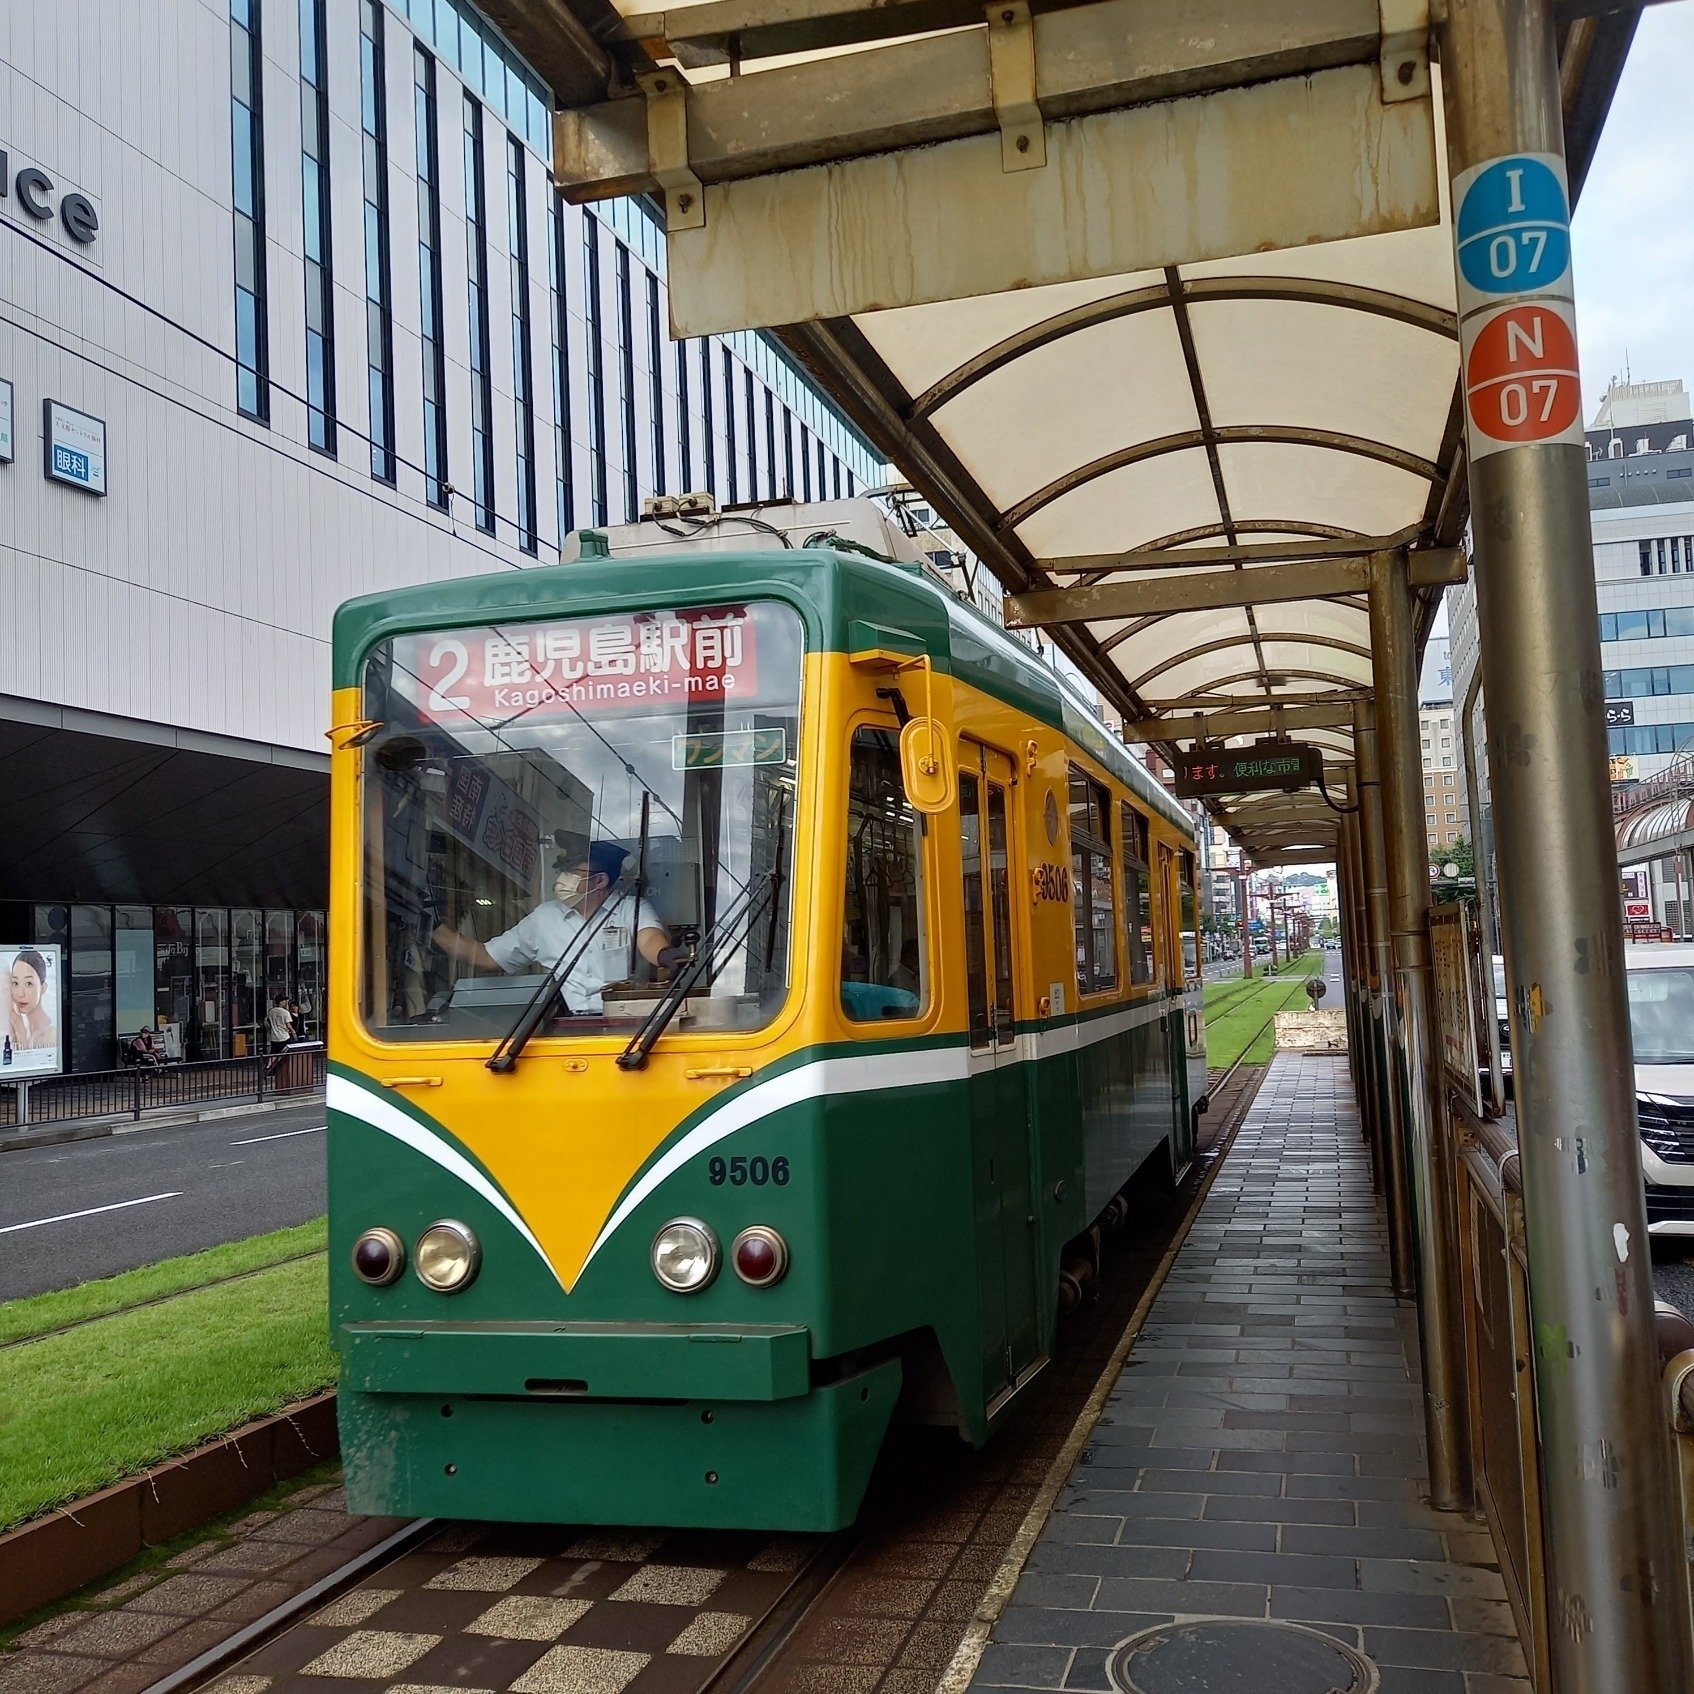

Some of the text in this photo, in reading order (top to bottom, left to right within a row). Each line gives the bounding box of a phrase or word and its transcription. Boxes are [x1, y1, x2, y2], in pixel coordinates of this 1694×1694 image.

[0, 149, 98, 243] ce
[1505, 169, 1526, 213] I
[1489, 231, 1547, 278] 07
[1507, 317, 1544, 363] N
[1500, 380, 1558, 427] 07
[57, 449, 86, 478] 眼科
[429, 612, 744, 712] 2 鹿児島駅前
[494, 671, 736, 708] Kagoshimaeki-mae
[1041, 862, 1069, 903] 9506
[708, 1156, 790, 1187] 9506
